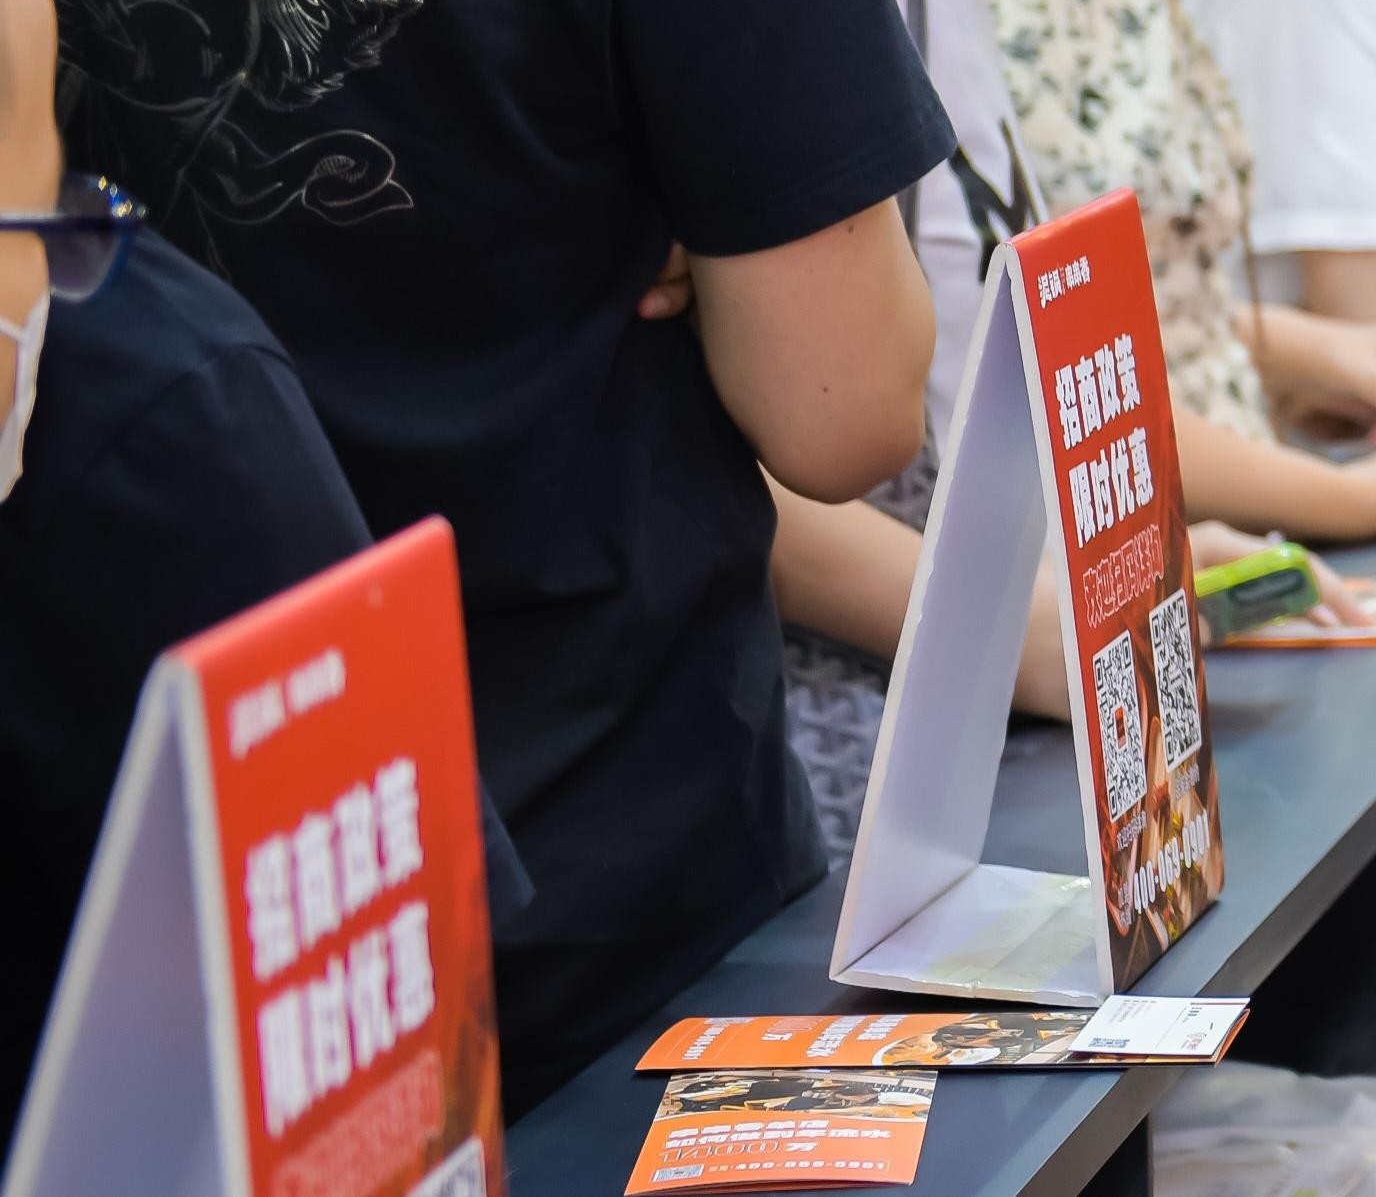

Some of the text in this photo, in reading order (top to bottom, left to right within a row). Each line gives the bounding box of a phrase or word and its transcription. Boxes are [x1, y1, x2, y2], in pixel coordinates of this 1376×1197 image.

[1055, 334, 1141, 450] 招商政策
[1069, 427, 1154, 548] 限时优惠
[1083, 524, 1165, 628] 欢迎扫码详询
[244, 757, 424, 983] 招商政策
[1132, 809, 1211, 915] 400-069-0901
[256, 899, 435, 1139] 限时优惠
